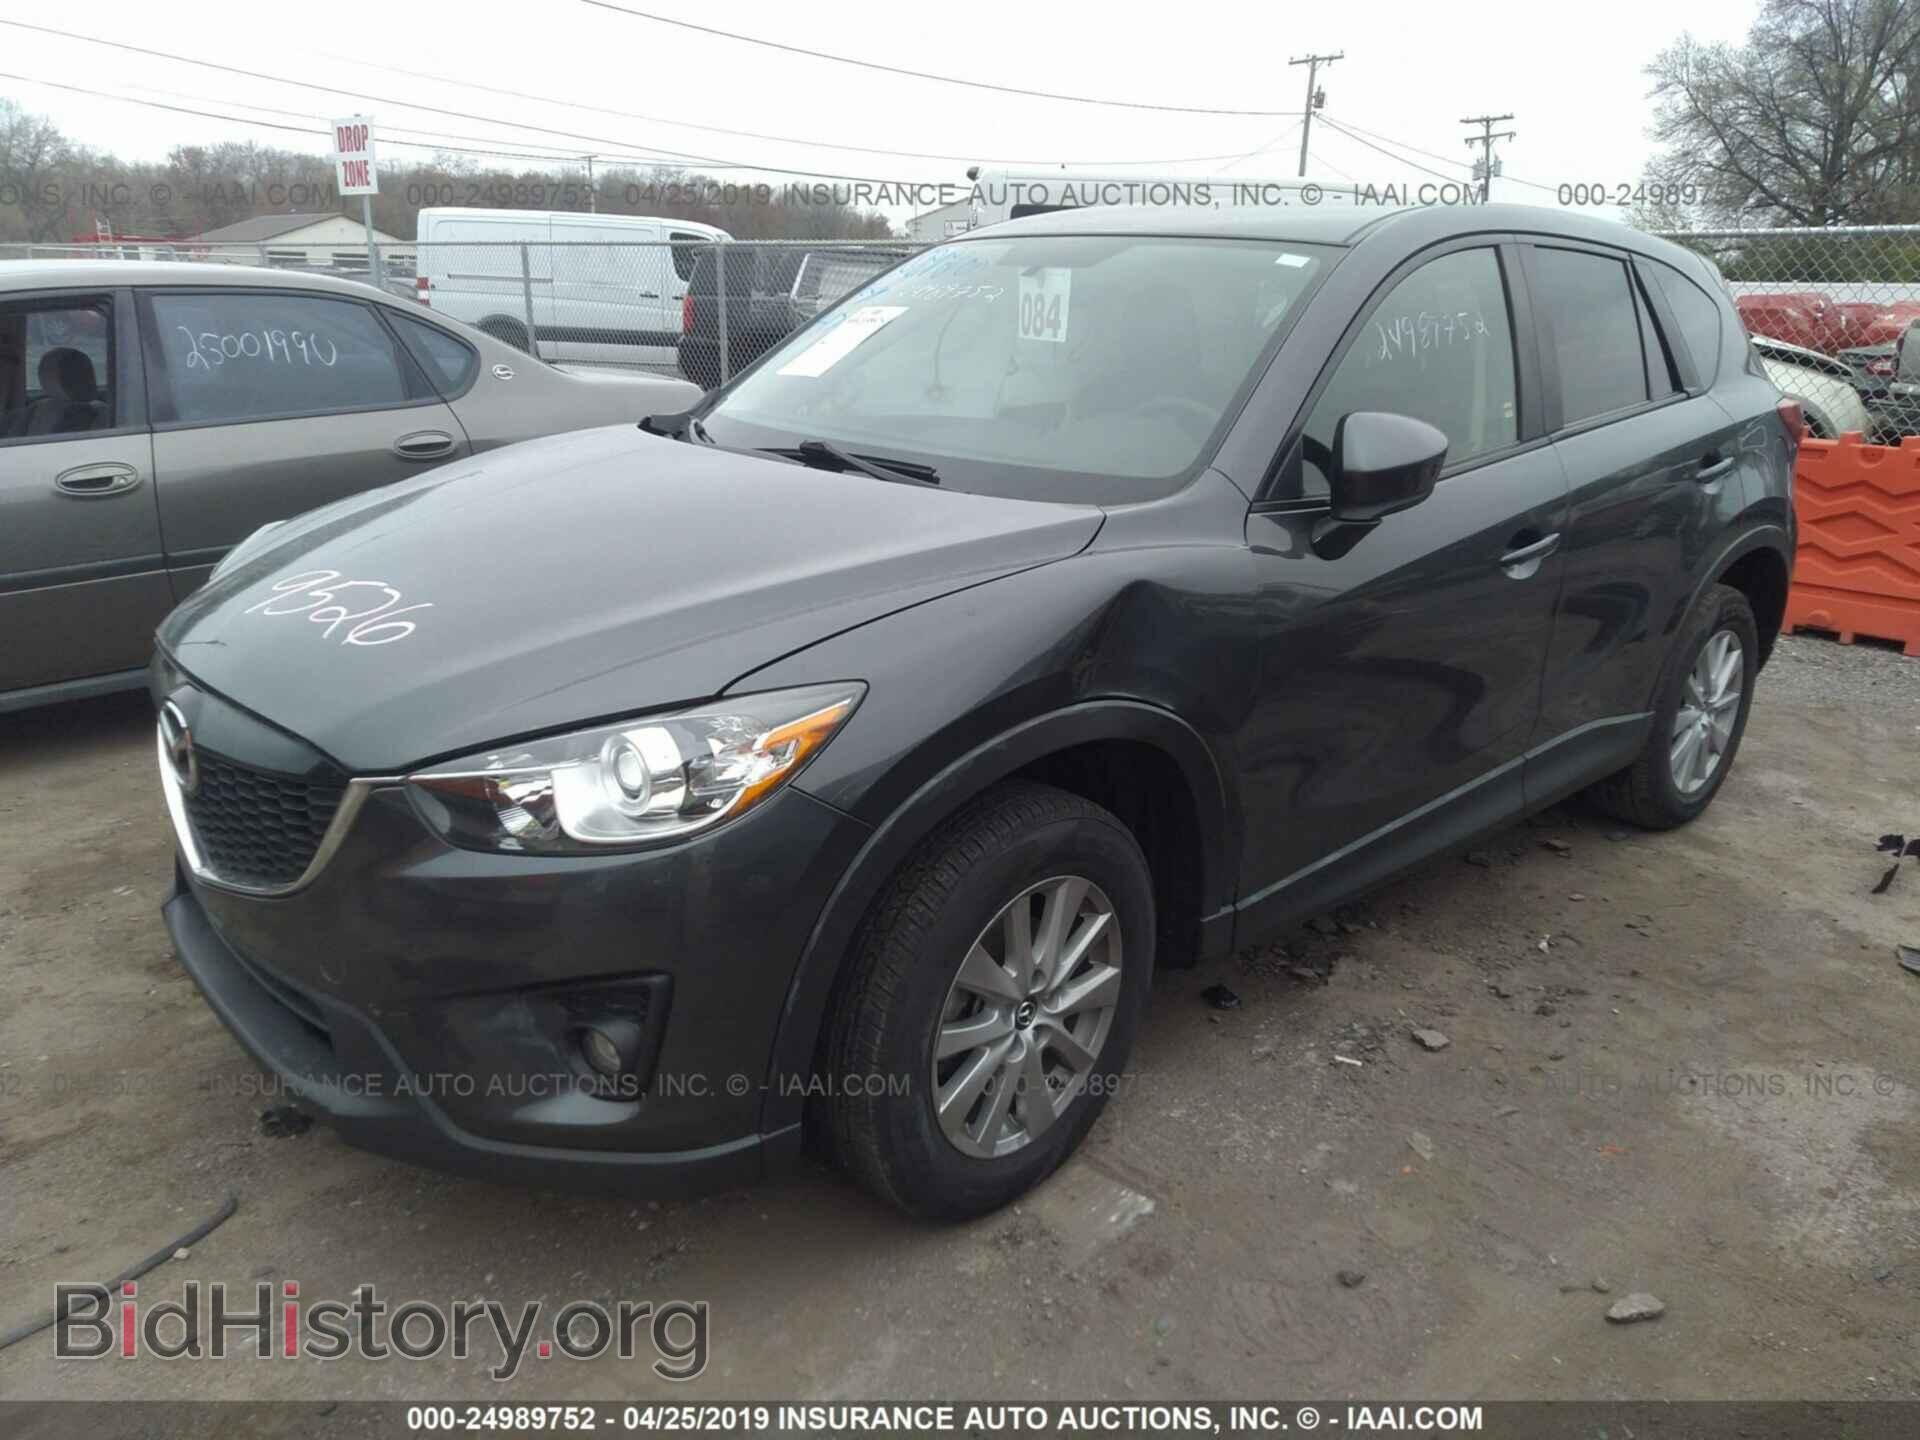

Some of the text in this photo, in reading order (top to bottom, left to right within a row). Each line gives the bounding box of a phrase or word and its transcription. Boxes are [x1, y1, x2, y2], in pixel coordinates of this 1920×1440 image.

[337, 124, 368, 153] DROP
[342, 159, 370, 187] ZONE
[1021, 293, 1064, 339] 084
